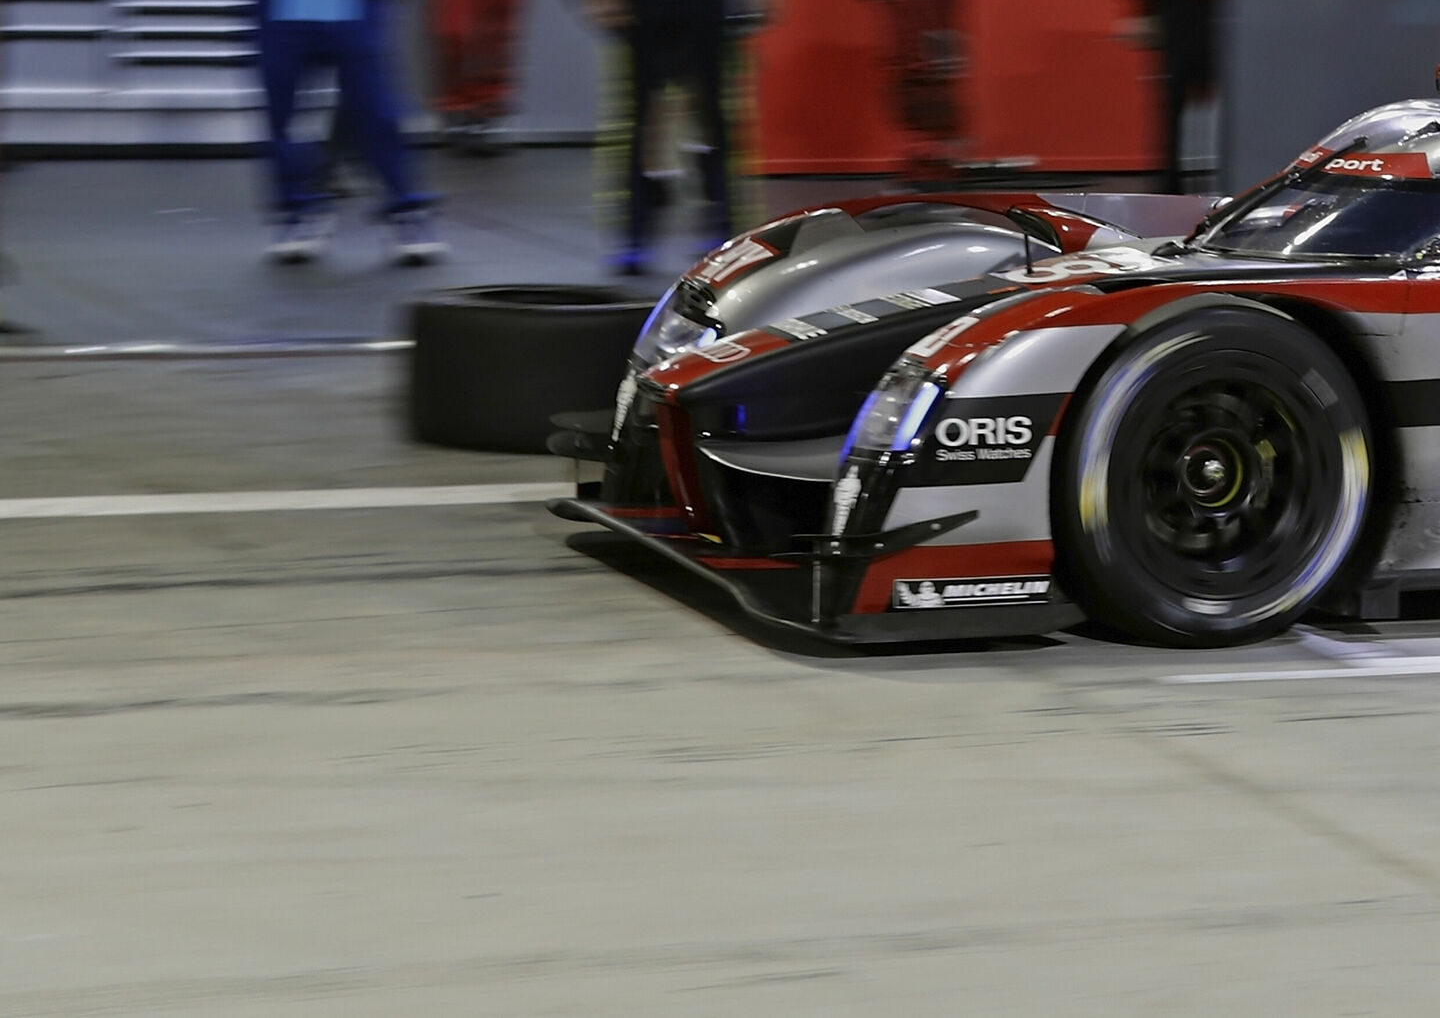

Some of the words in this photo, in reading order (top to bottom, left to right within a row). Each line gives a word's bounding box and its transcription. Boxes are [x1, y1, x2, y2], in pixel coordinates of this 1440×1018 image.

[1324, 158, 1385, 172] port
[935, 416, 1033, 447] ORIS
[935, 449, 976, 461] Swiss
[976, 448, 1032, 460] Watches
[942, 581, 1051, 598] MICHELIN
